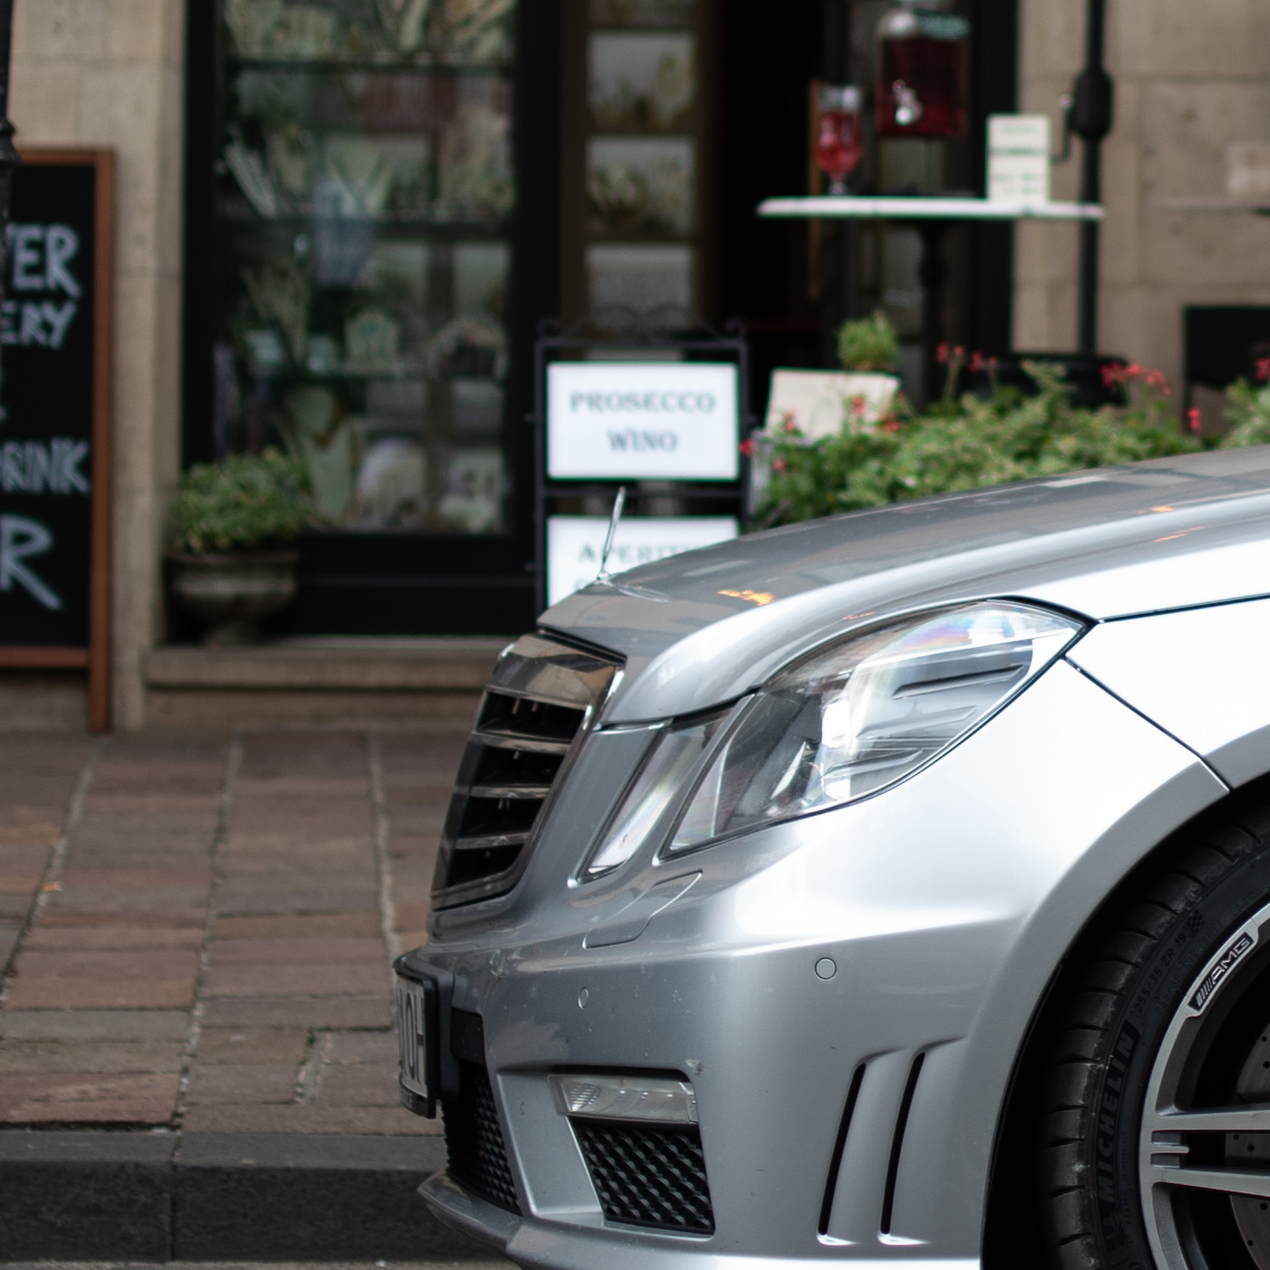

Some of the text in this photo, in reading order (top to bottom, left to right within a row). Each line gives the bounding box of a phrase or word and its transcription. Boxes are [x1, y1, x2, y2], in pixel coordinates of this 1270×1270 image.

[570, 391, 716, 413] PROSECCO
[1133, 931, 1188, 1014] 255/35 ZR 19
[1211, 937, 1251, 985] AMG
[1097, 1031, 1135, 1205] MICHELIN
